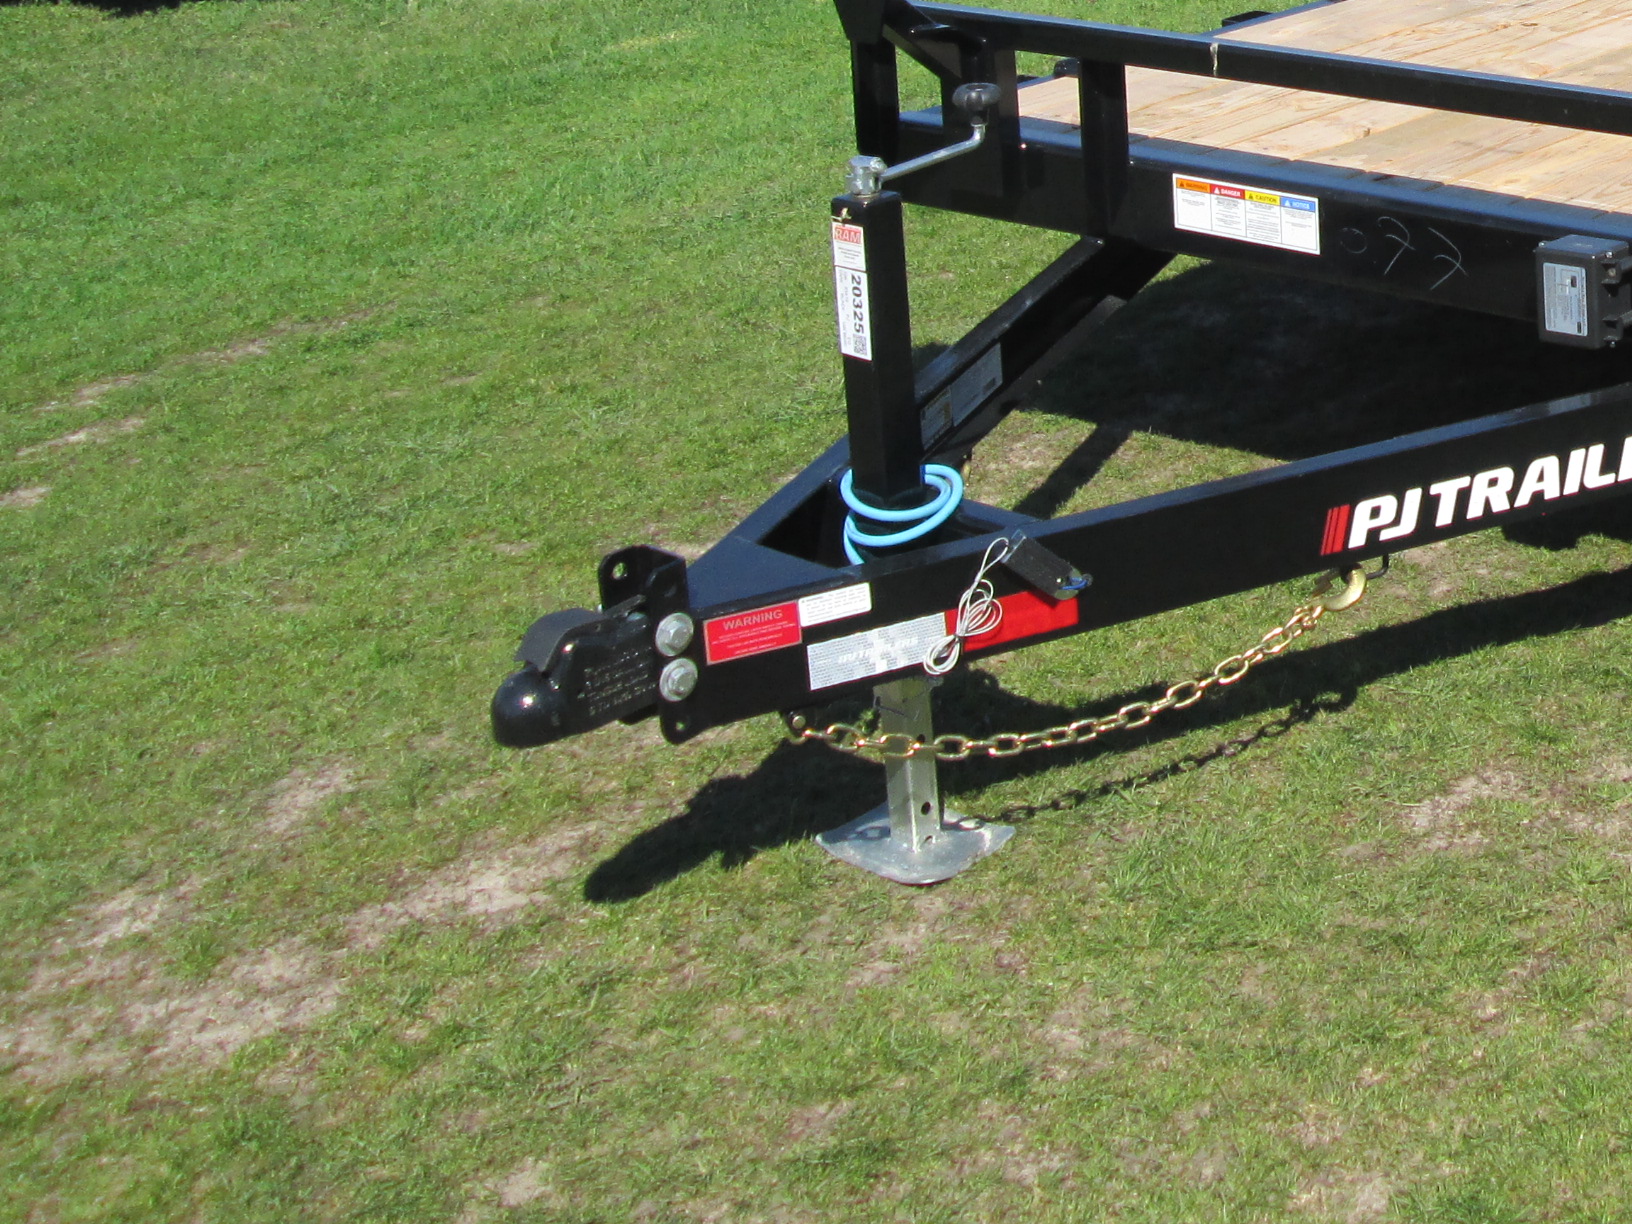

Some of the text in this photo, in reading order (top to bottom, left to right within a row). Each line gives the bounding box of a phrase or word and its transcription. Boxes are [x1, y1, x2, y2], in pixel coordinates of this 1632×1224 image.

[1220, 188, 1242, 197] DANGER
[1255, 194, 1277, 204] CAUTION
[835, 229, 861, 244] RAM
[851, 274, 864, 335] 20325
[1347, 486, 1422, 550] PJ
[722, 609, 784, 631] WARNING
